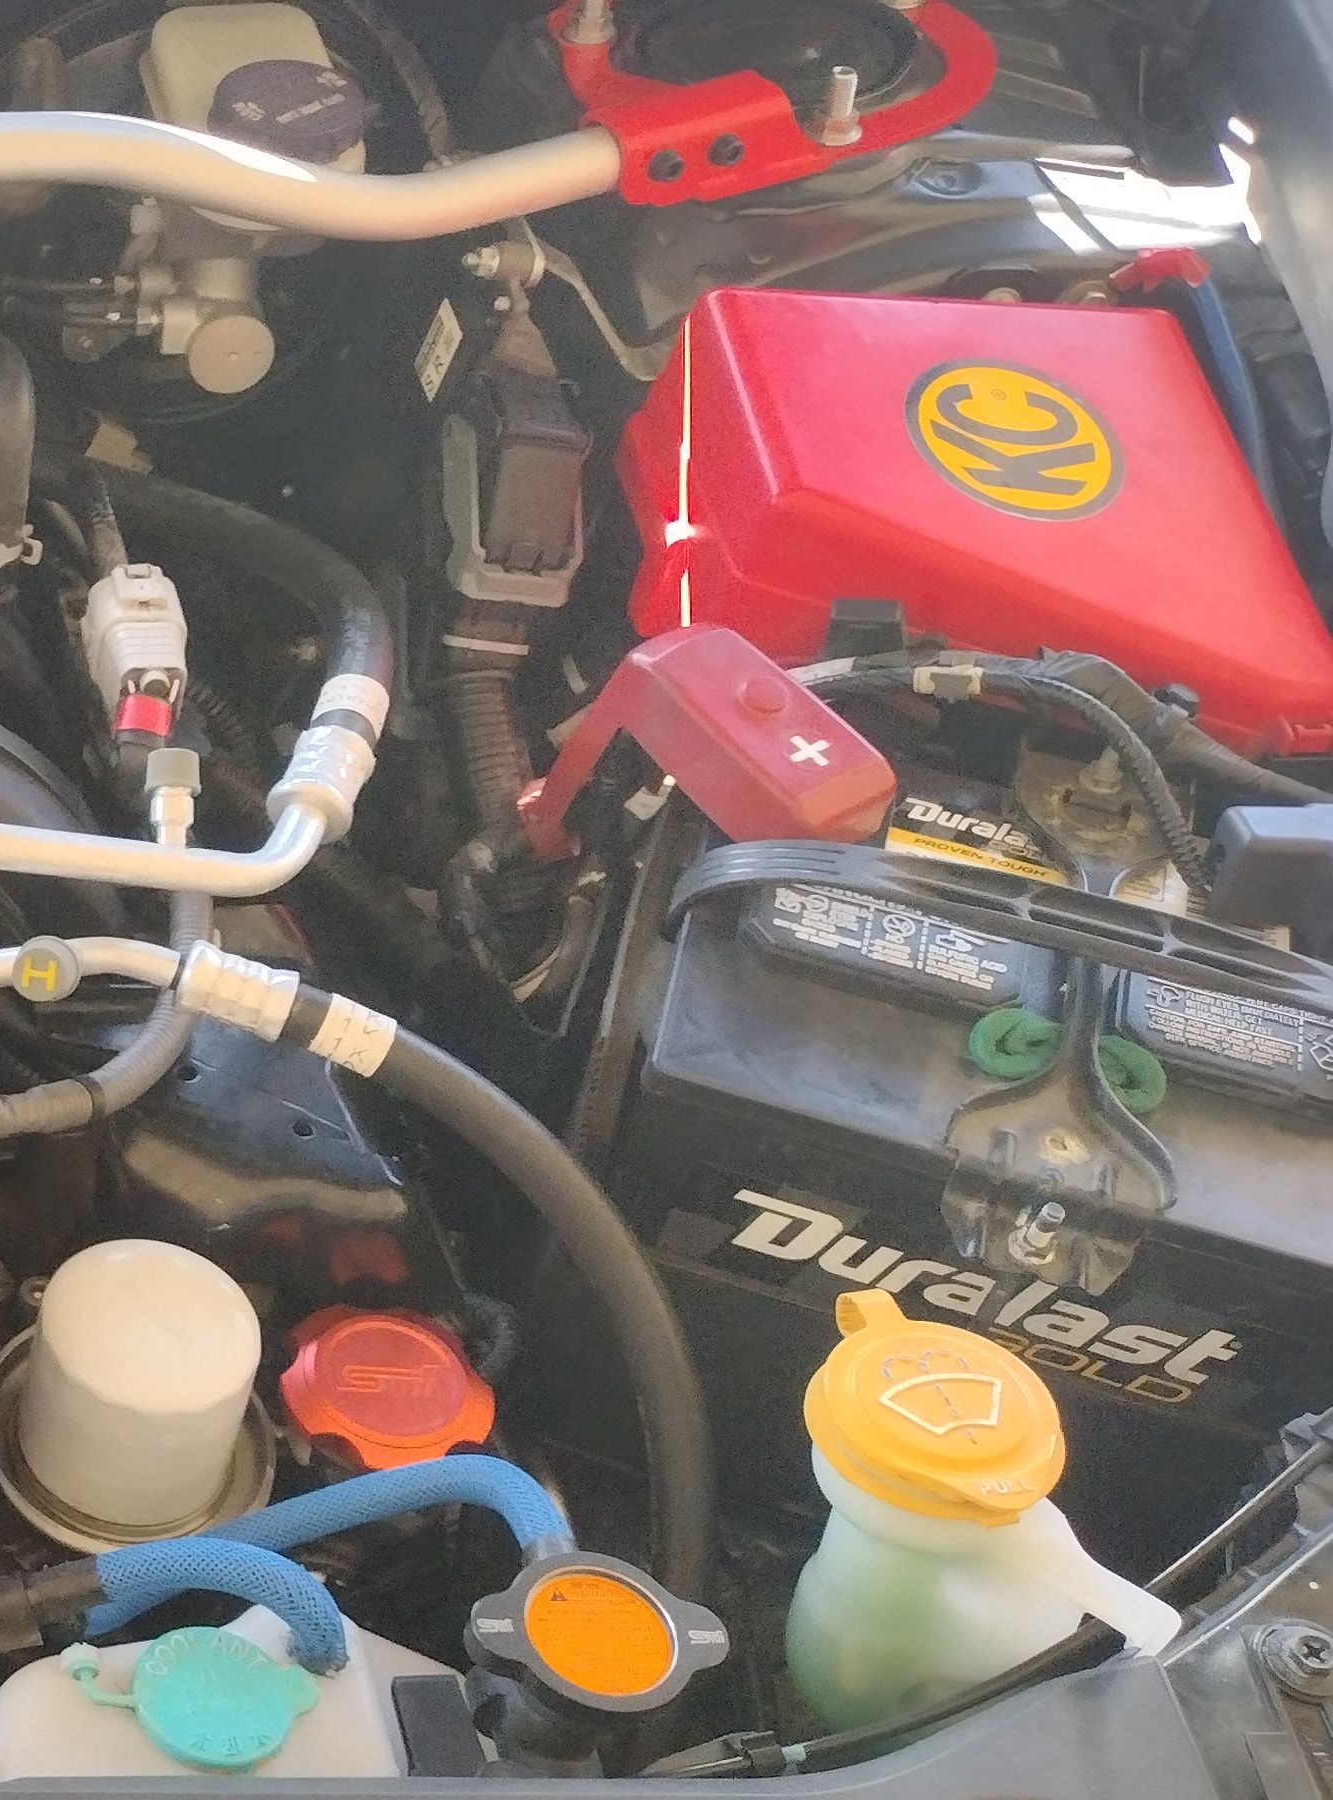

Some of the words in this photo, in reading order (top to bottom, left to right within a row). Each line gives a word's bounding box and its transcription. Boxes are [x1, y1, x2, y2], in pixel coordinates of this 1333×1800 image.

[930, 384, 1096, 496] KC
[913, 838, 983, 859] PROVEN
[989, 857, 1047, 877] TOUGH
[21, 954, 58, 992] H
[732, 1189, 1238, 1383] Duralast
[979, 1479, 1036, 1496] PULL
